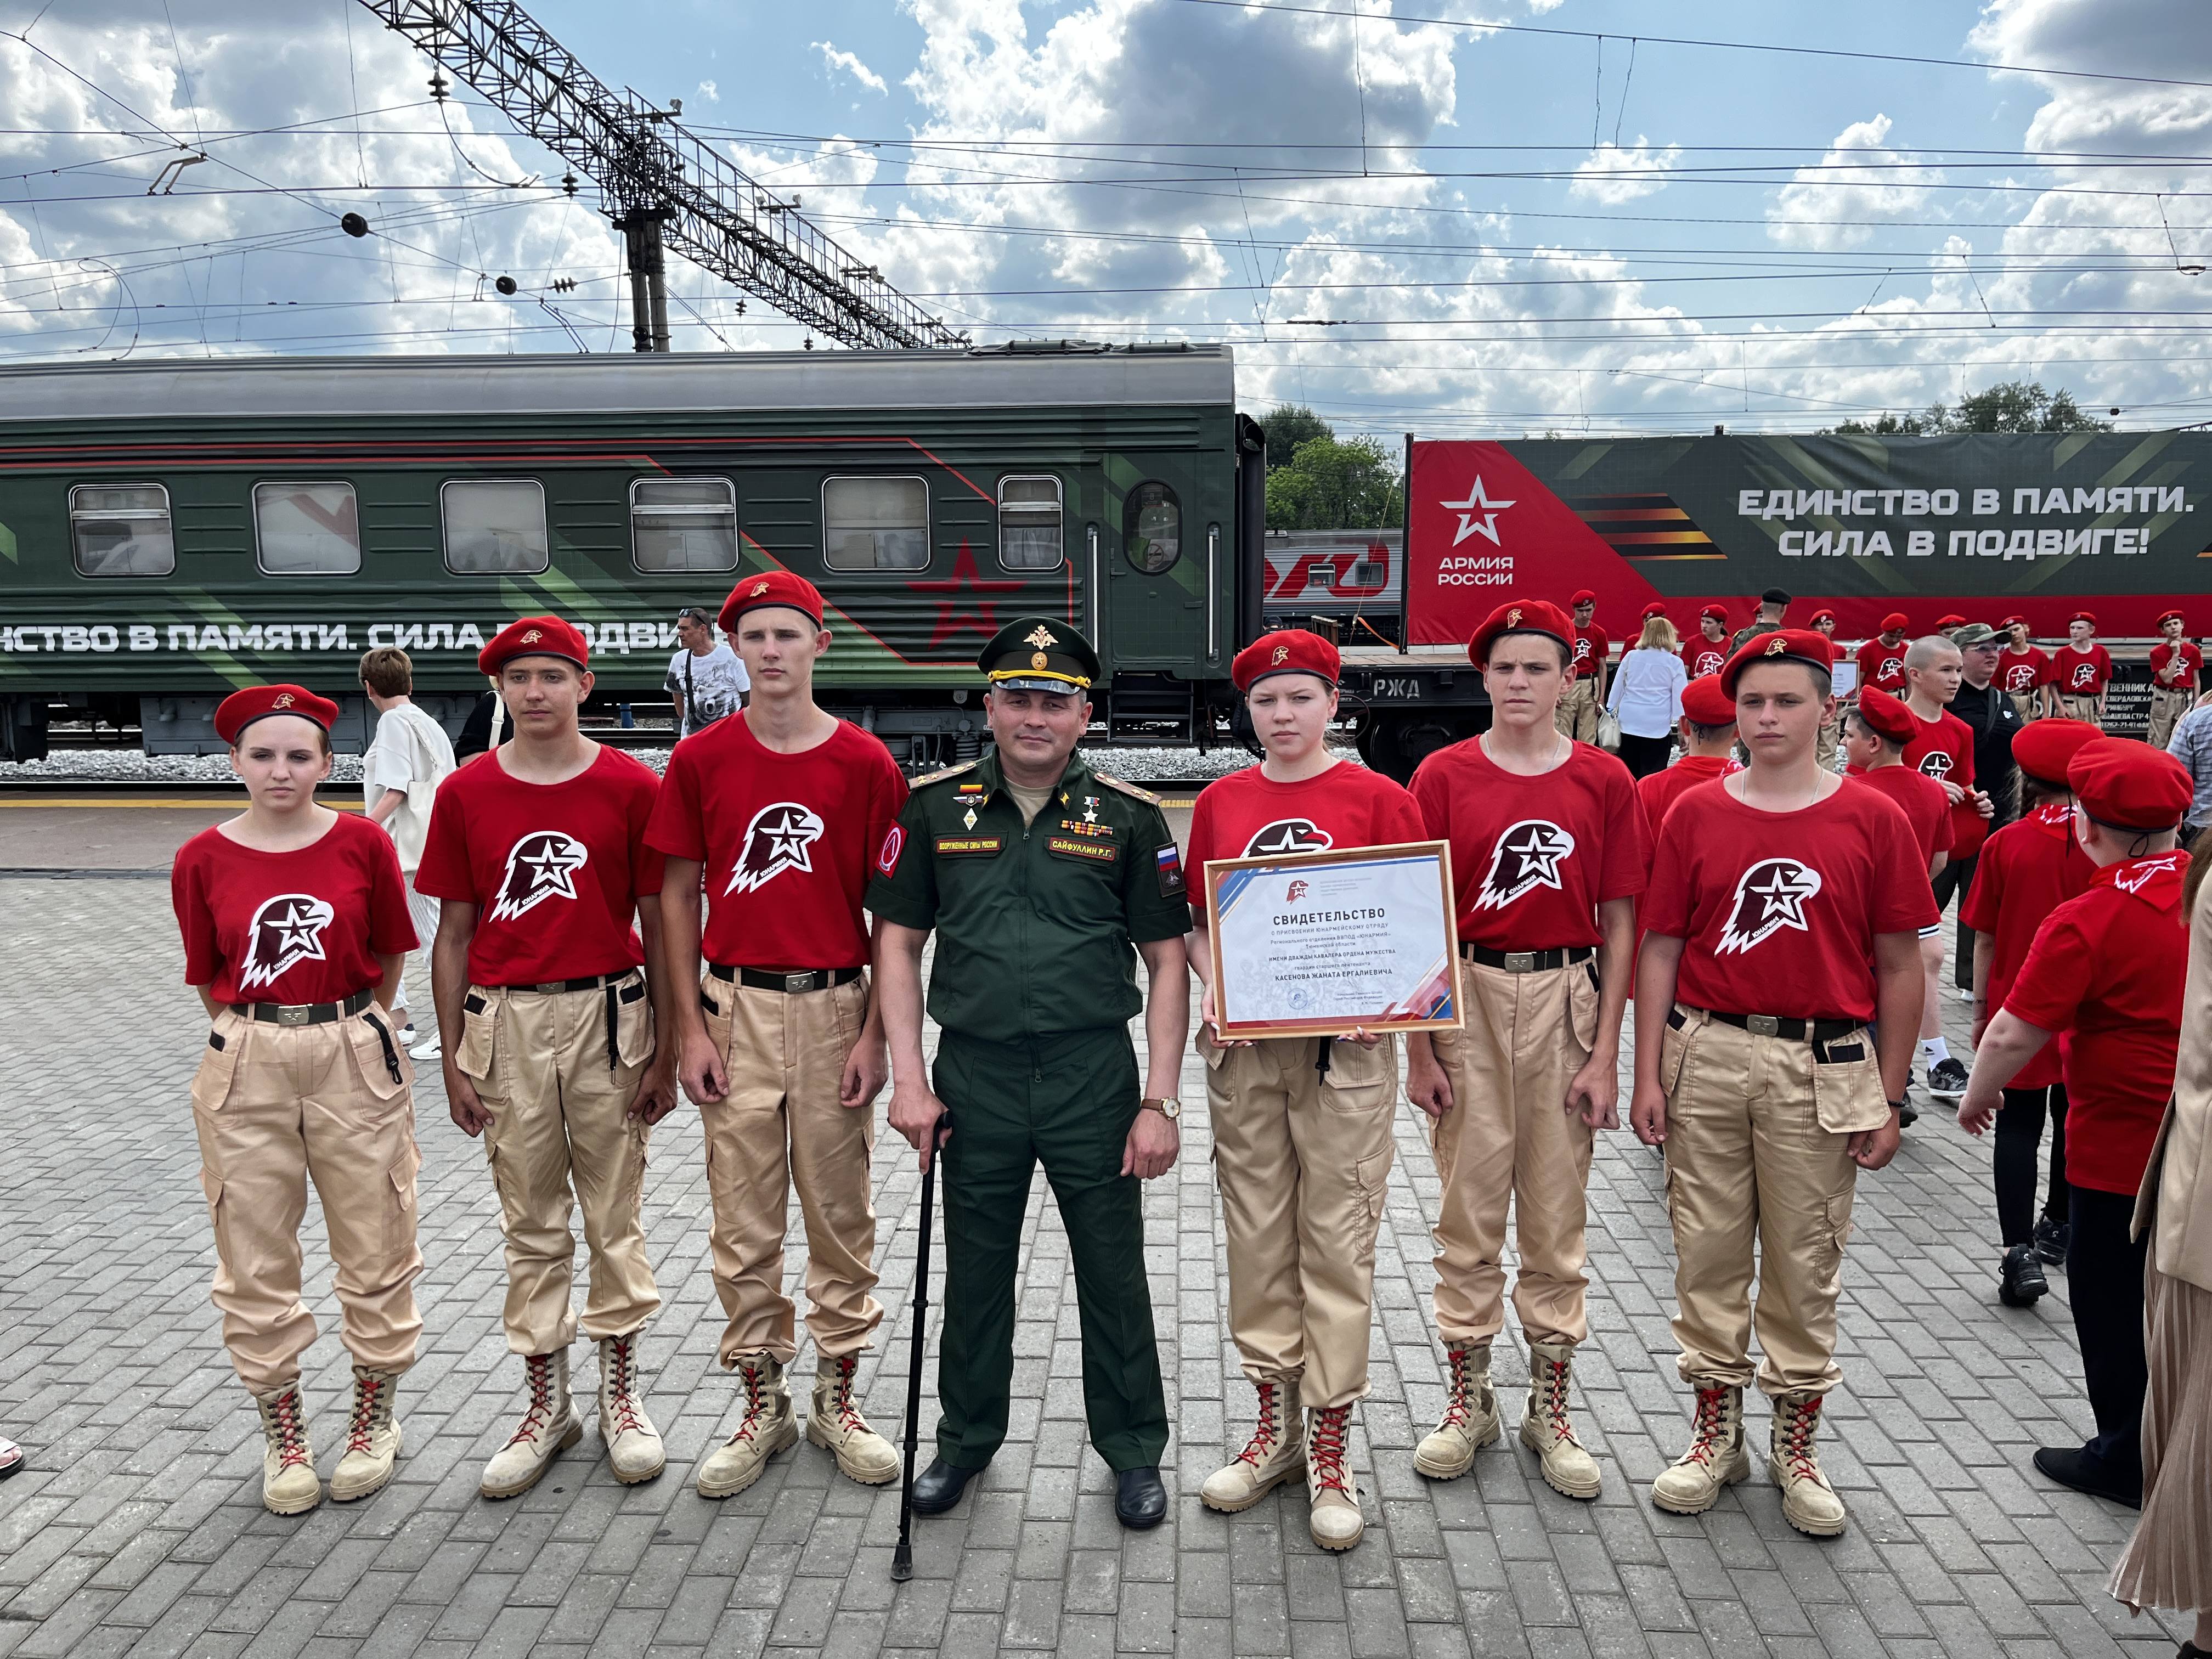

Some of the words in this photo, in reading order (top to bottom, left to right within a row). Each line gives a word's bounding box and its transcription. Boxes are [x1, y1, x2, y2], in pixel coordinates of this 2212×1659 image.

[1738, 488, 1959, 520] ЕДИНСТВО
[1972, 488, 2001, 514] В
[2013, 487, 2194, 515] ПАМЯТИ.
[1778, 530, 1894, 557] СИЛА
[1907, 530, 1936, 556] В
[1948, 528, 2149, 561] ПОДВИГЕ!
[1438, 557, 1514, 570] АРМИЯ
[1438, 573, 1513, 585] РОССИИ
[129, 625, 159, 651] В
[168, 624, 357, 651] ПАМЯТИ.
[368, 623, 484, 650] СИЛА
[1373, 679, 1420, 699] РЖД
[939, 842, 968, 850] ВООРУЖЕННЫЕ
[969, 841, 980, 849] СИЛЫ
[1052, 840, 1097, 855] САЙФУЛЛИН
[1098, 849, 1112, 857] Р.Г.
[521, 884, 550, 906] ЮНАРМИЯ
[1273, 908, 1385, 926] СВИДЕТЕЛЬСТВО
[1316, 924, 1364, 933] ЮНАРМЕЙСКОМУ
[1342, 968, 1393, 978] ЕРГАЛИЕВИЧА
